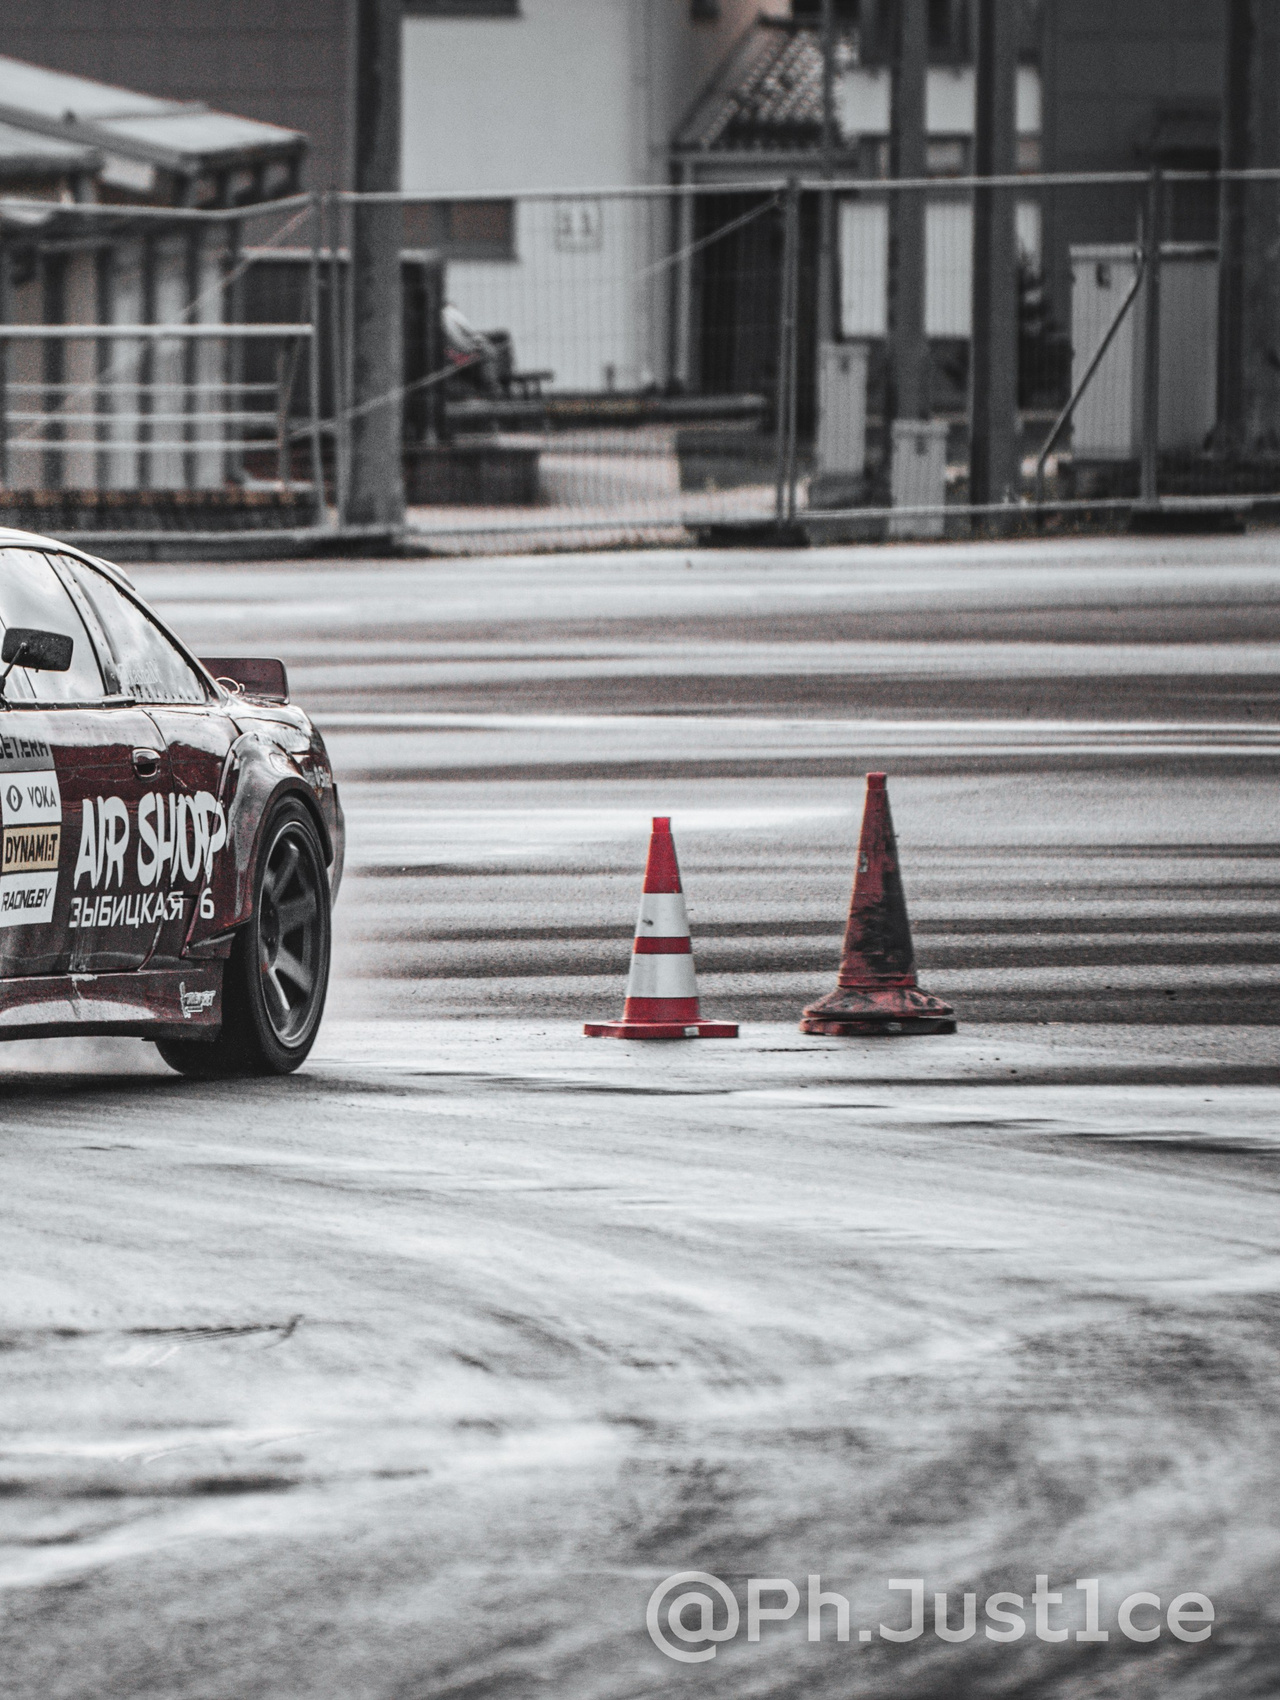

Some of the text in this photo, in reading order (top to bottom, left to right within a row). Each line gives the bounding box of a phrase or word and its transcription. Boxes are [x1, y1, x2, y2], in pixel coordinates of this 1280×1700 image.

[27, 785, 57, 809] VOKA
[74, 791, 227, 890] AIR SHOP
[69, 887, 215, 929] ЗЫБИЦКАЯ 6
